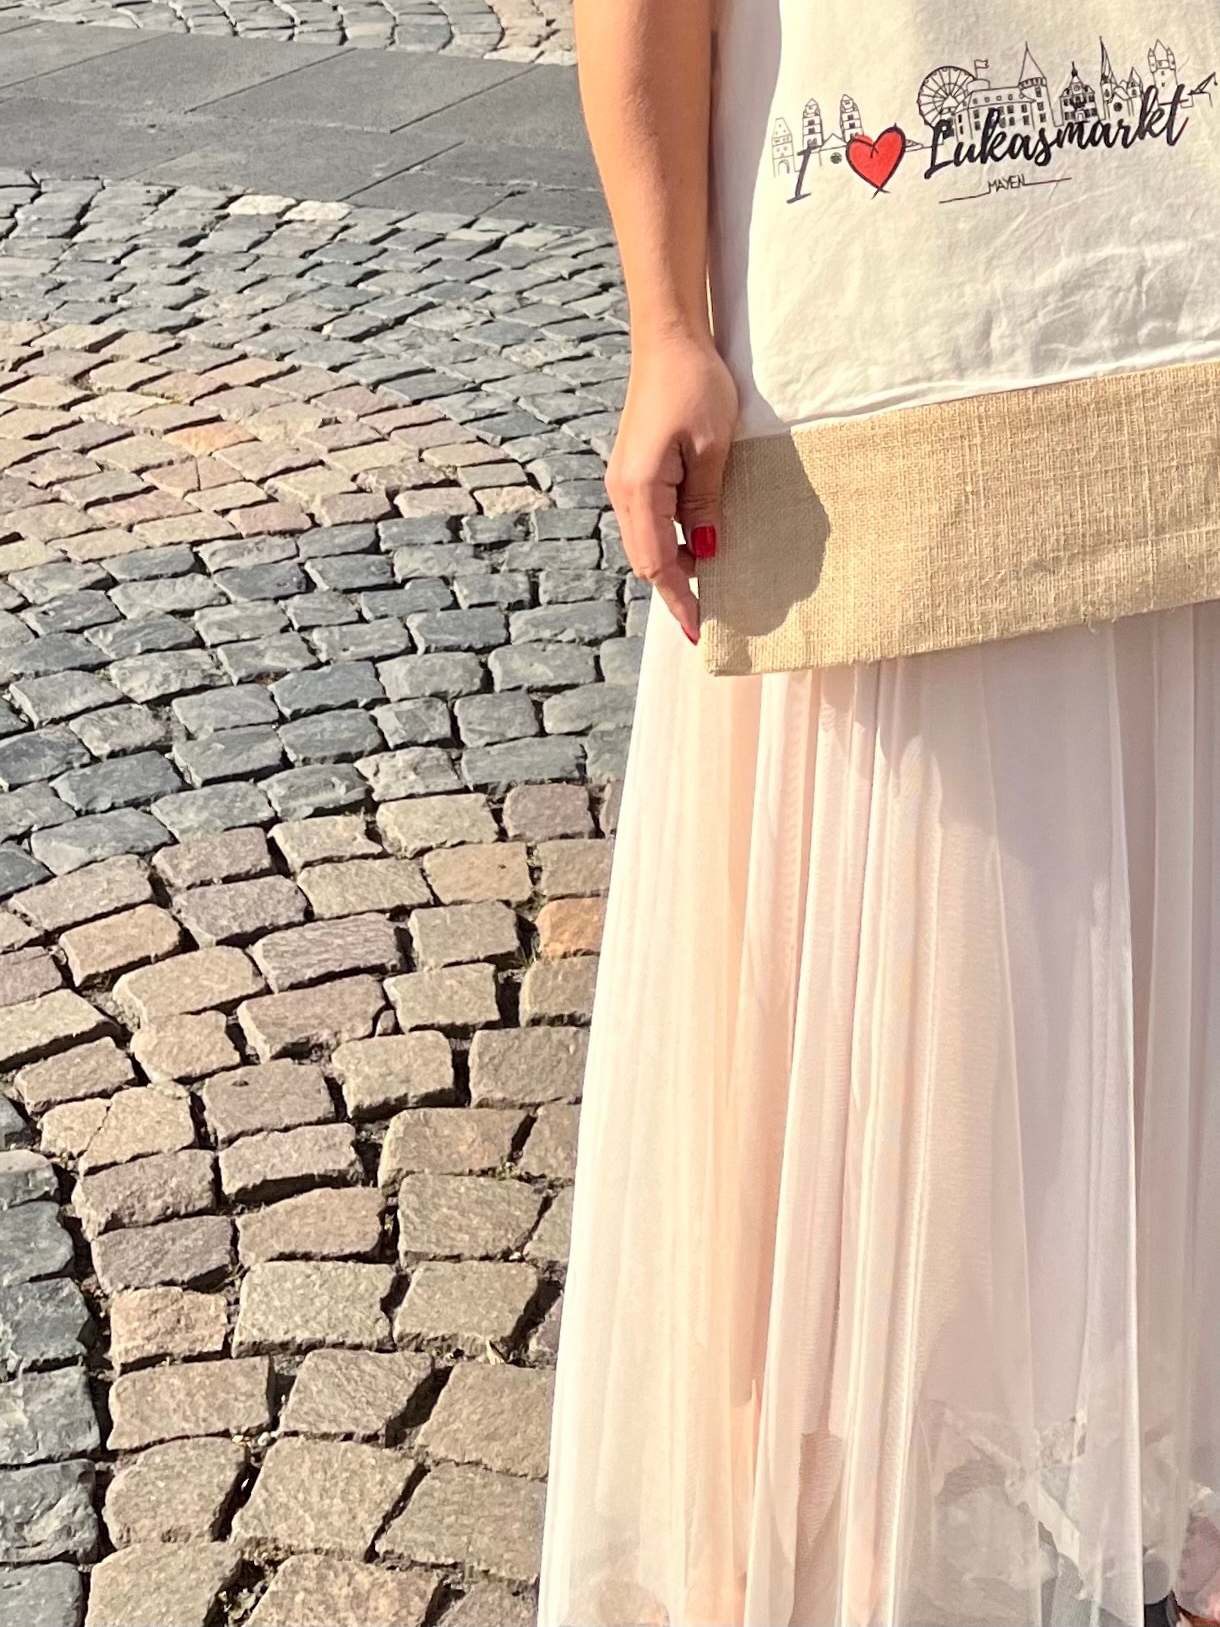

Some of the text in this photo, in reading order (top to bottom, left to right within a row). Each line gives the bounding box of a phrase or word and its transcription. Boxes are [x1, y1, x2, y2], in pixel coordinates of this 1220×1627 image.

[786, 84, 1191, 204] I Lukasmarkt
[987, 173, 1026, 194] MAYEN
